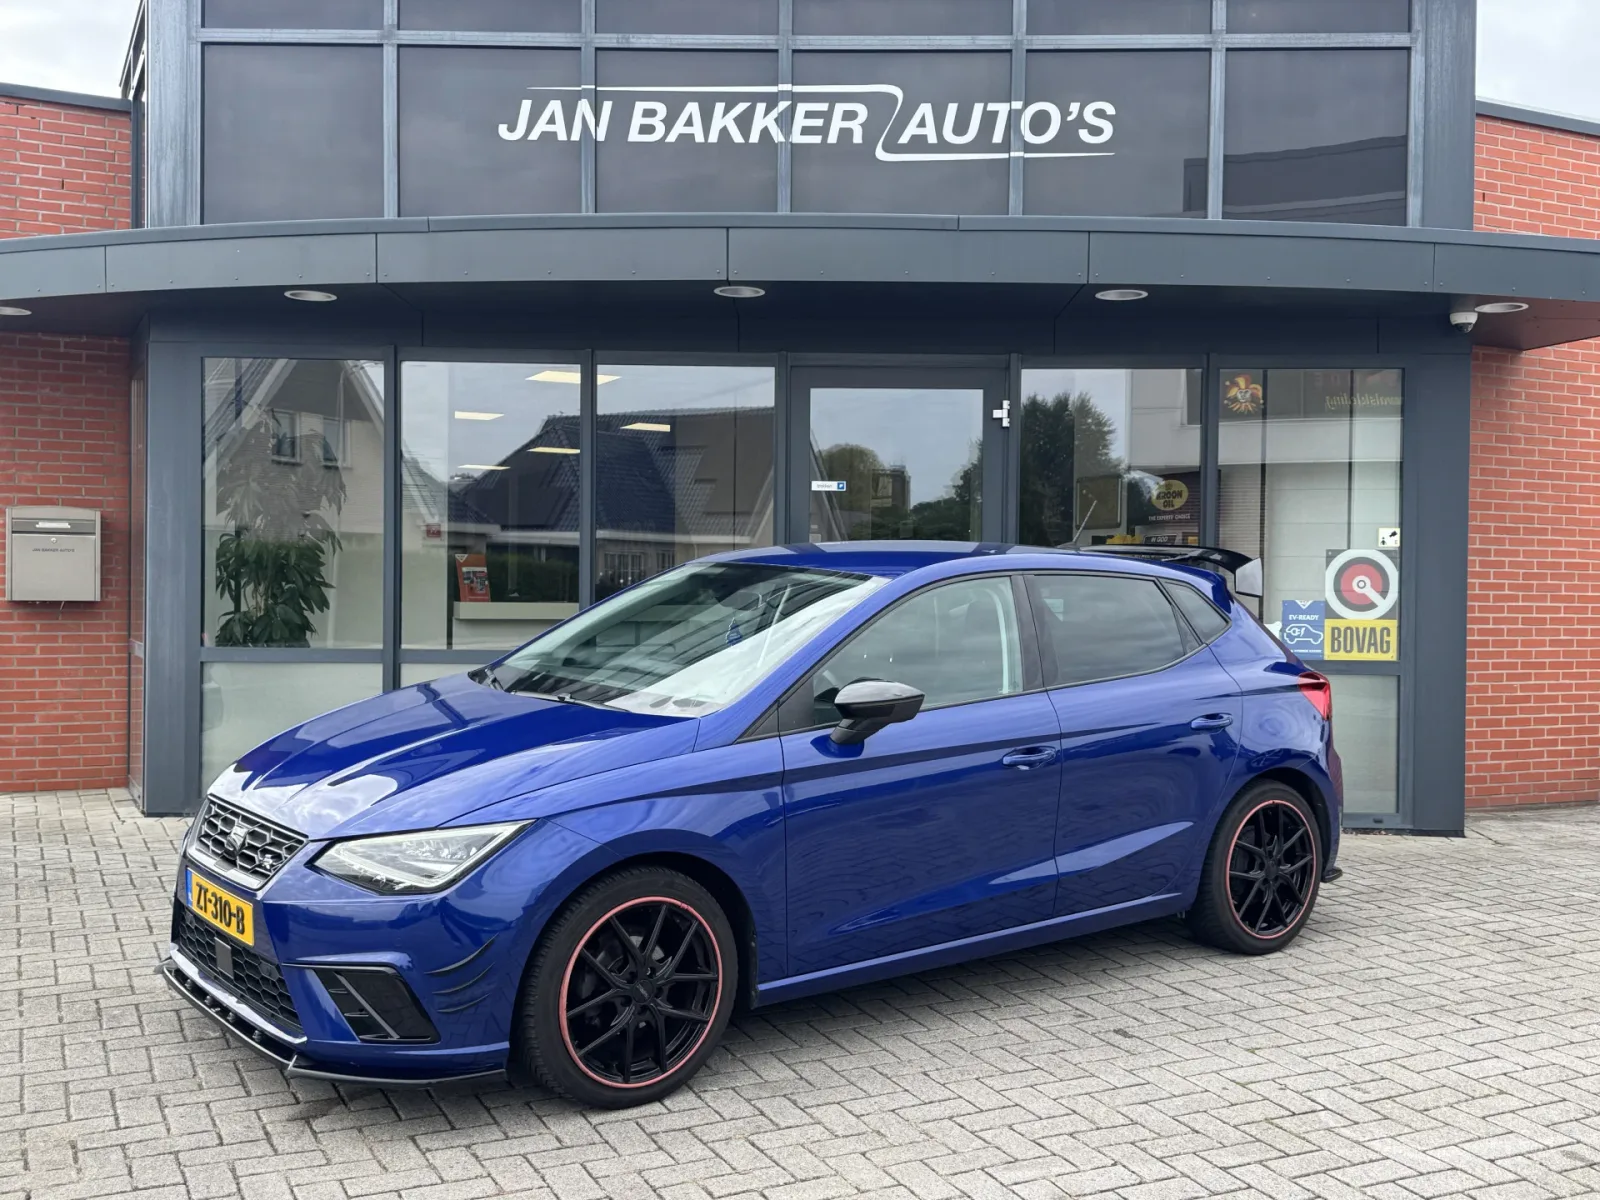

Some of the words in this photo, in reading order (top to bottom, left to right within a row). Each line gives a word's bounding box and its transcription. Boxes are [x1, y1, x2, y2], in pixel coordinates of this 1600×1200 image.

[497, 99, 609, 142] JAN
[628, 101, 868, 144] BAKKER
[897, 100, 1116, 145] AUTO'S
[1163, 500, 1175, 509] OIL
[1330, 626, 1391, 654] BOVAG
[195, 881, 246, 935] ZT-310-B
